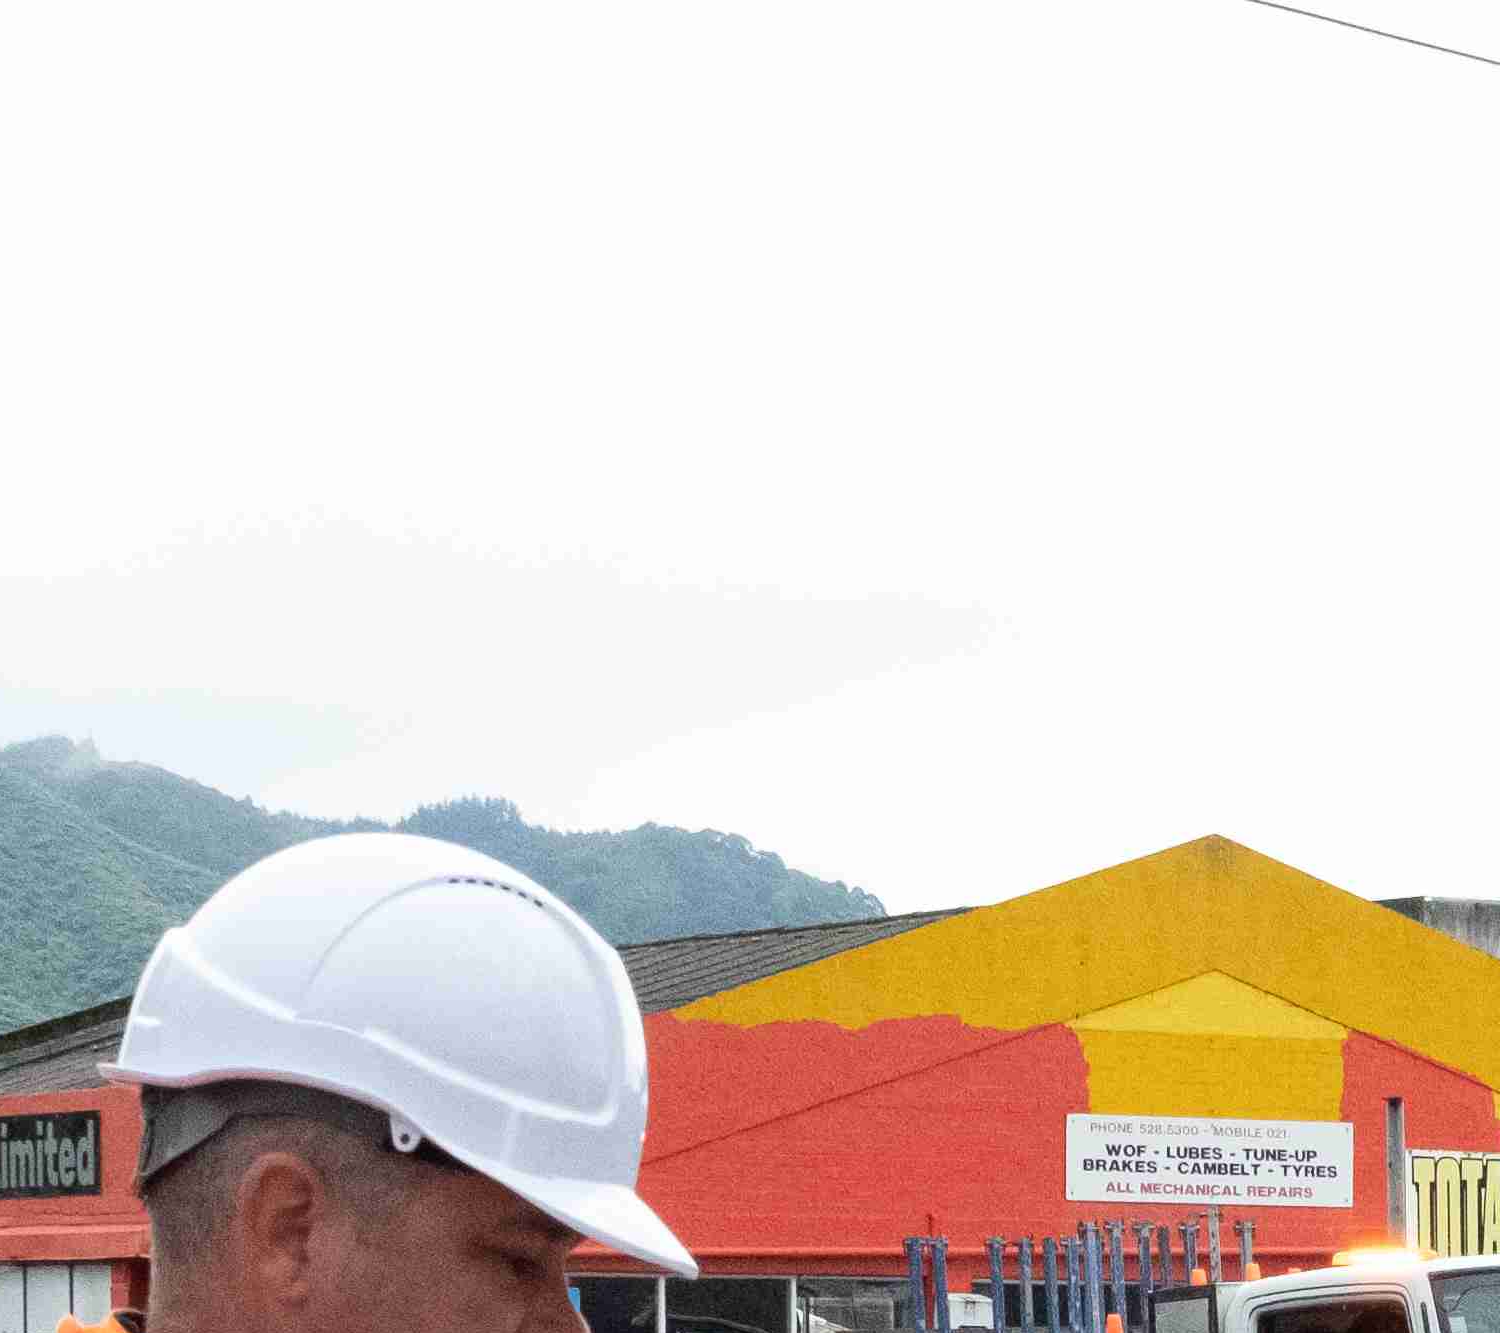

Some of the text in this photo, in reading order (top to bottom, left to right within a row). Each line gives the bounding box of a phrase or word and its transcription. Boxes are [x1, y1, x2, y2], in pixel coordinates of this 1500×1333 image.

[1090, 1121, 1133, 1135] PHONE
[1213, 1125, 1262, 1139] MOBILE
[1105, 1144, 1147, 1157] WOF
[1166, 1146, 1223, 1160] LUBES
[1242, 1148, 1318, 1163] TUNE-UP
[1083, 1159, 1158, 1174] BRAKES
[1178, 1162, 1261, 1177] CAMBELT
[1281, 1164, 1338, 1178] TYRES
[1106, 1181, 1313, 1199] ALL MECHANICAL REPAIRS
